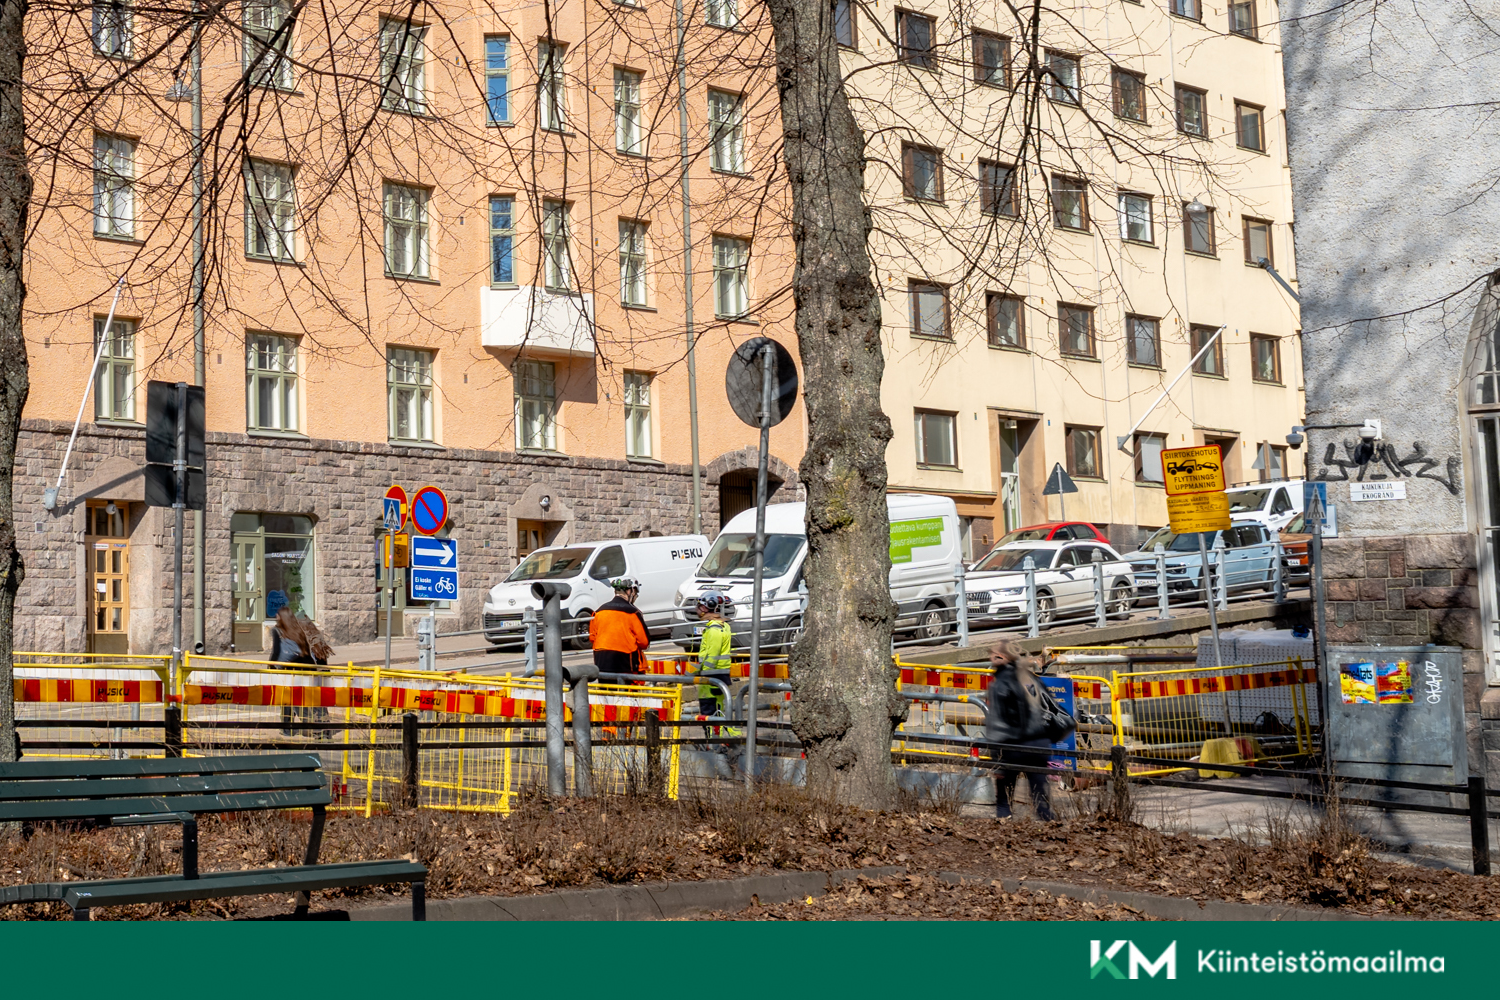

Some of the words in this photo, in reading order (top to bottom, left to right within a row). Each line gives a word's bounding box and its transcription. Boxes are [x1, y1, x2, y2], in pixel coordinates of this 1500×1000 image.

[1164, 449, 1218, 459] SIIRTOKEHOTUS
[1174, 474, 1218, 483] FLYTTNINGS-
[1175, 481, 1216, 490] UPPMANING
[890, 524, 916, 534] uotettava
[671, 548, 703, 560] PUSKU
[947, 677, 973, 685] PUSKU
[98, 688, 129, 696] PUSKU
[202, 692, 233, 700] PUSKU
[413, 695, 441, 706] PUSKU
